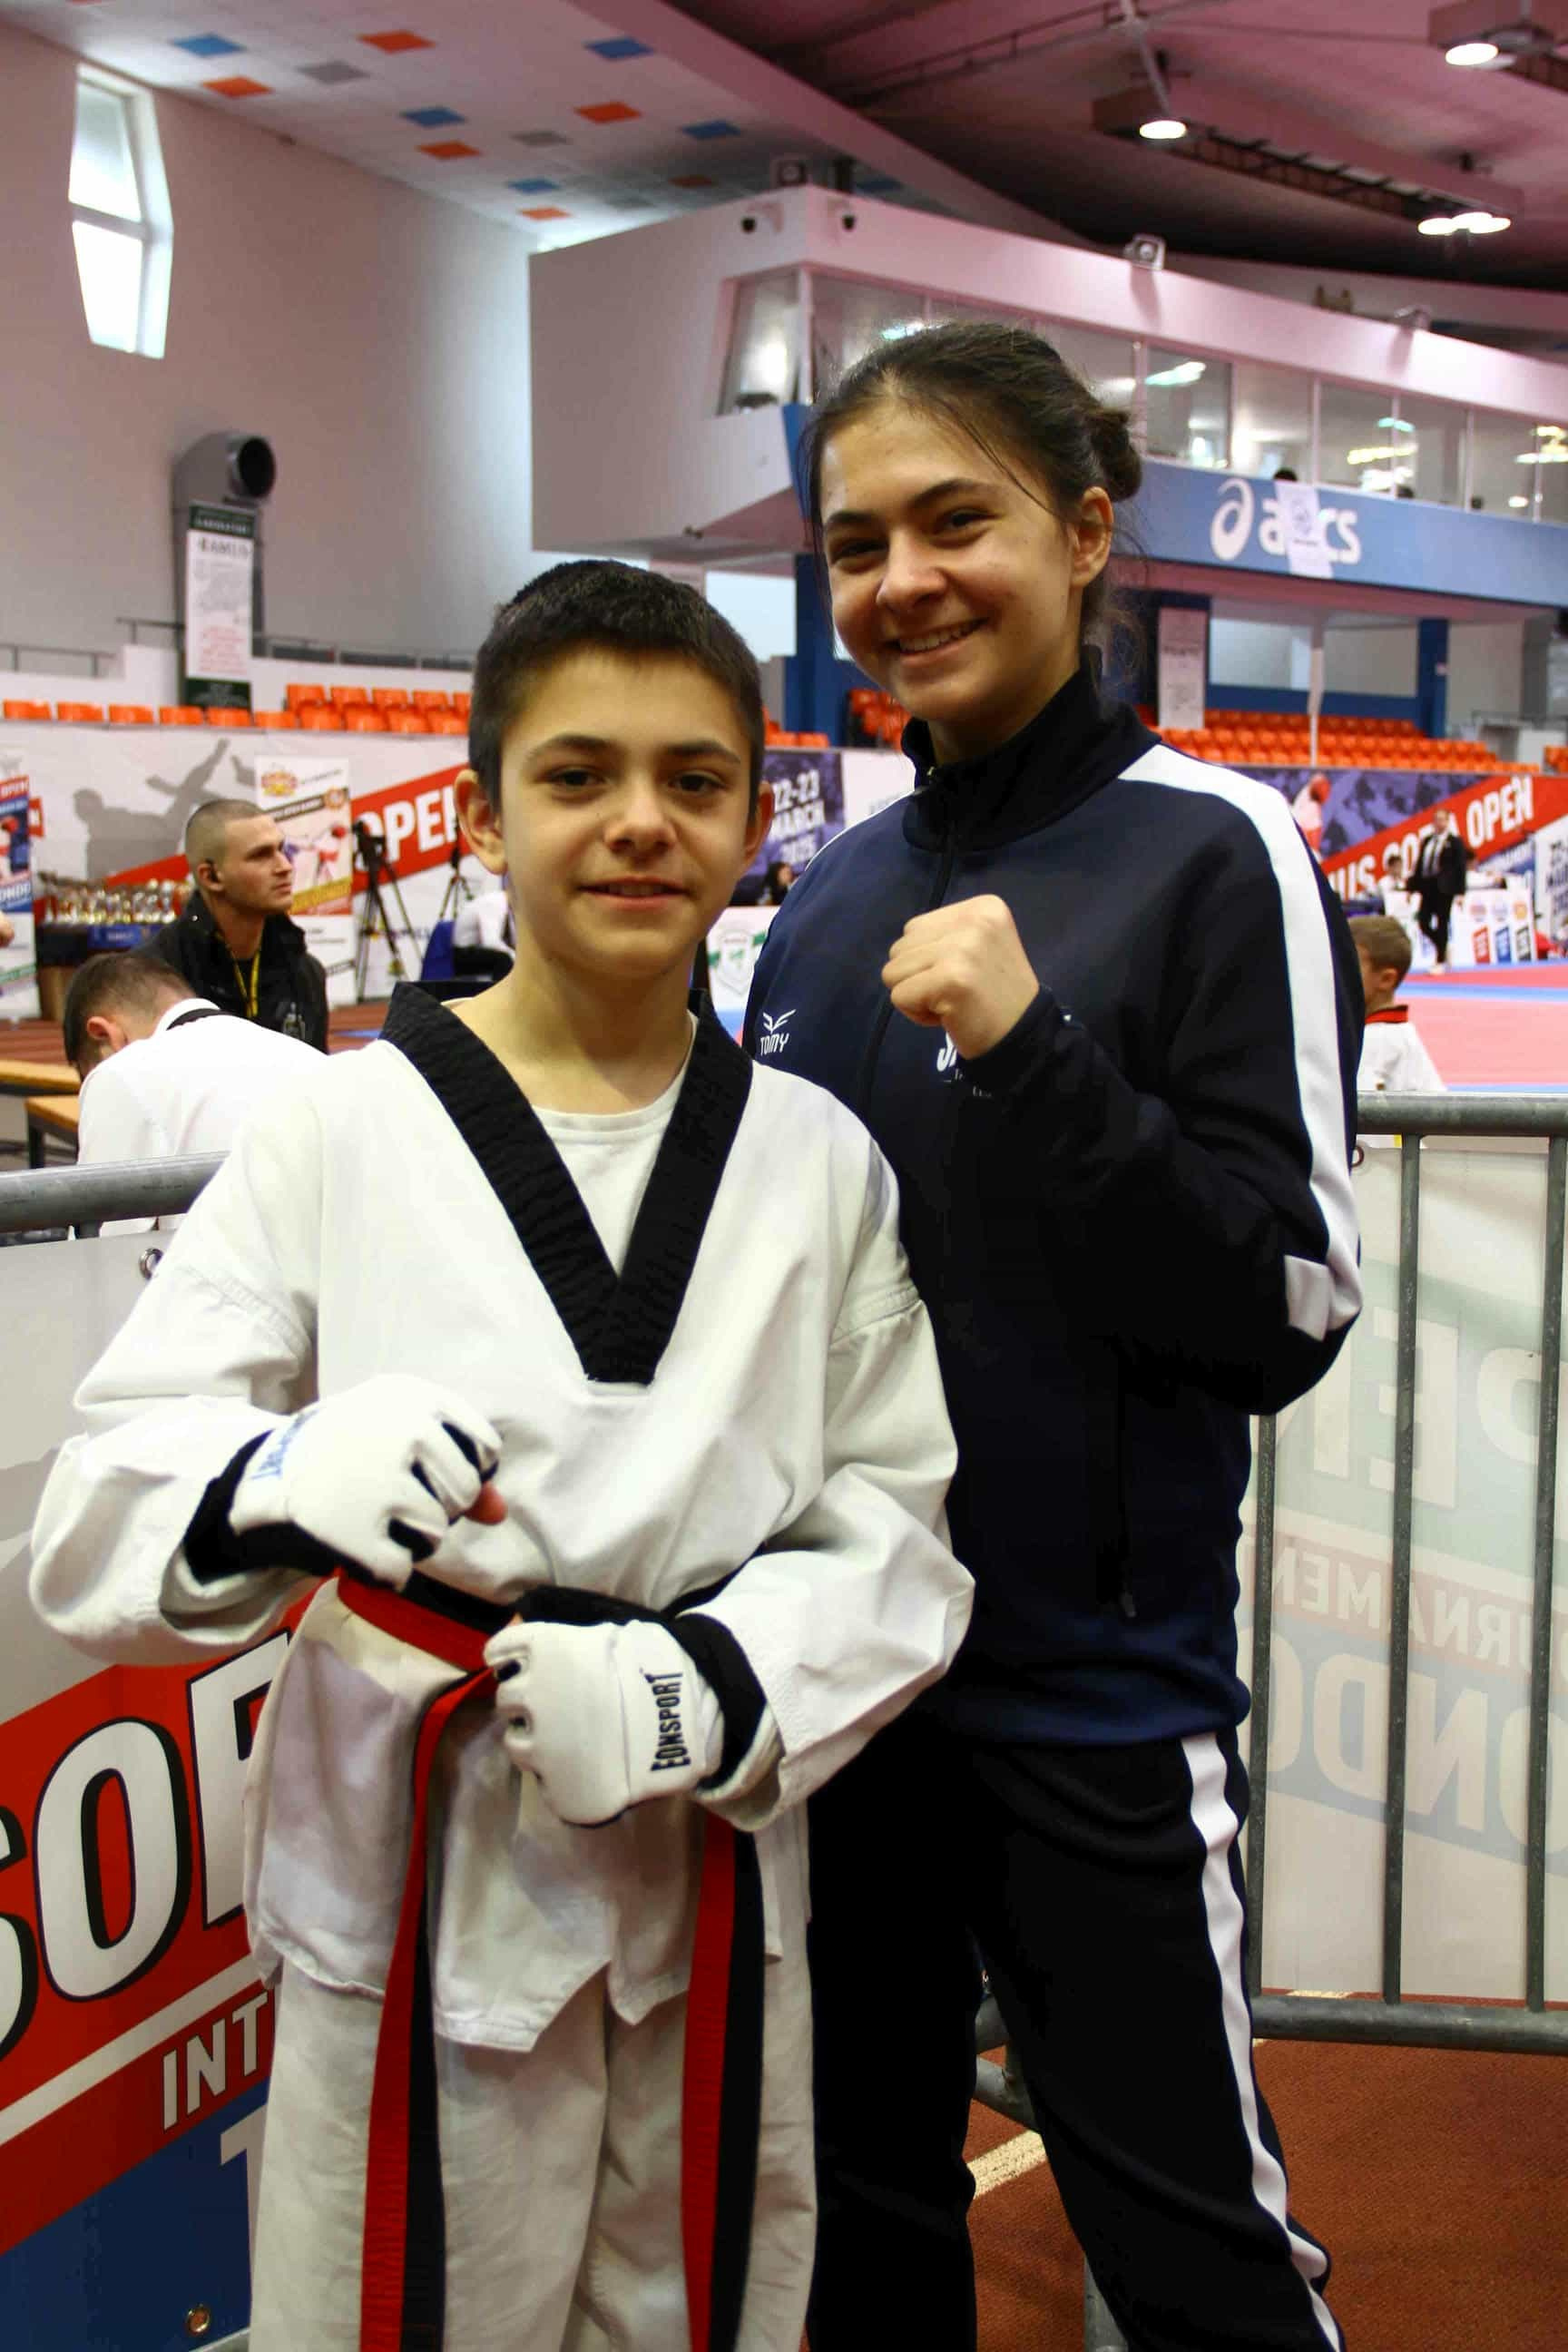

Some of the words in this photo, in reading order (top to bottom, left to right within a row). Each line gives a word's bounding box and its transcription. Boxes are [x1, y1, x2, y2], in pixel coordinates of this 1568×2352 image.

[1258, 497, 1360, 565] acs
[1466, 775, 1534, 848] OPEN
[760, 1033, 789, 1056] TOMY
[163, 1991, 270, 2133] INT
